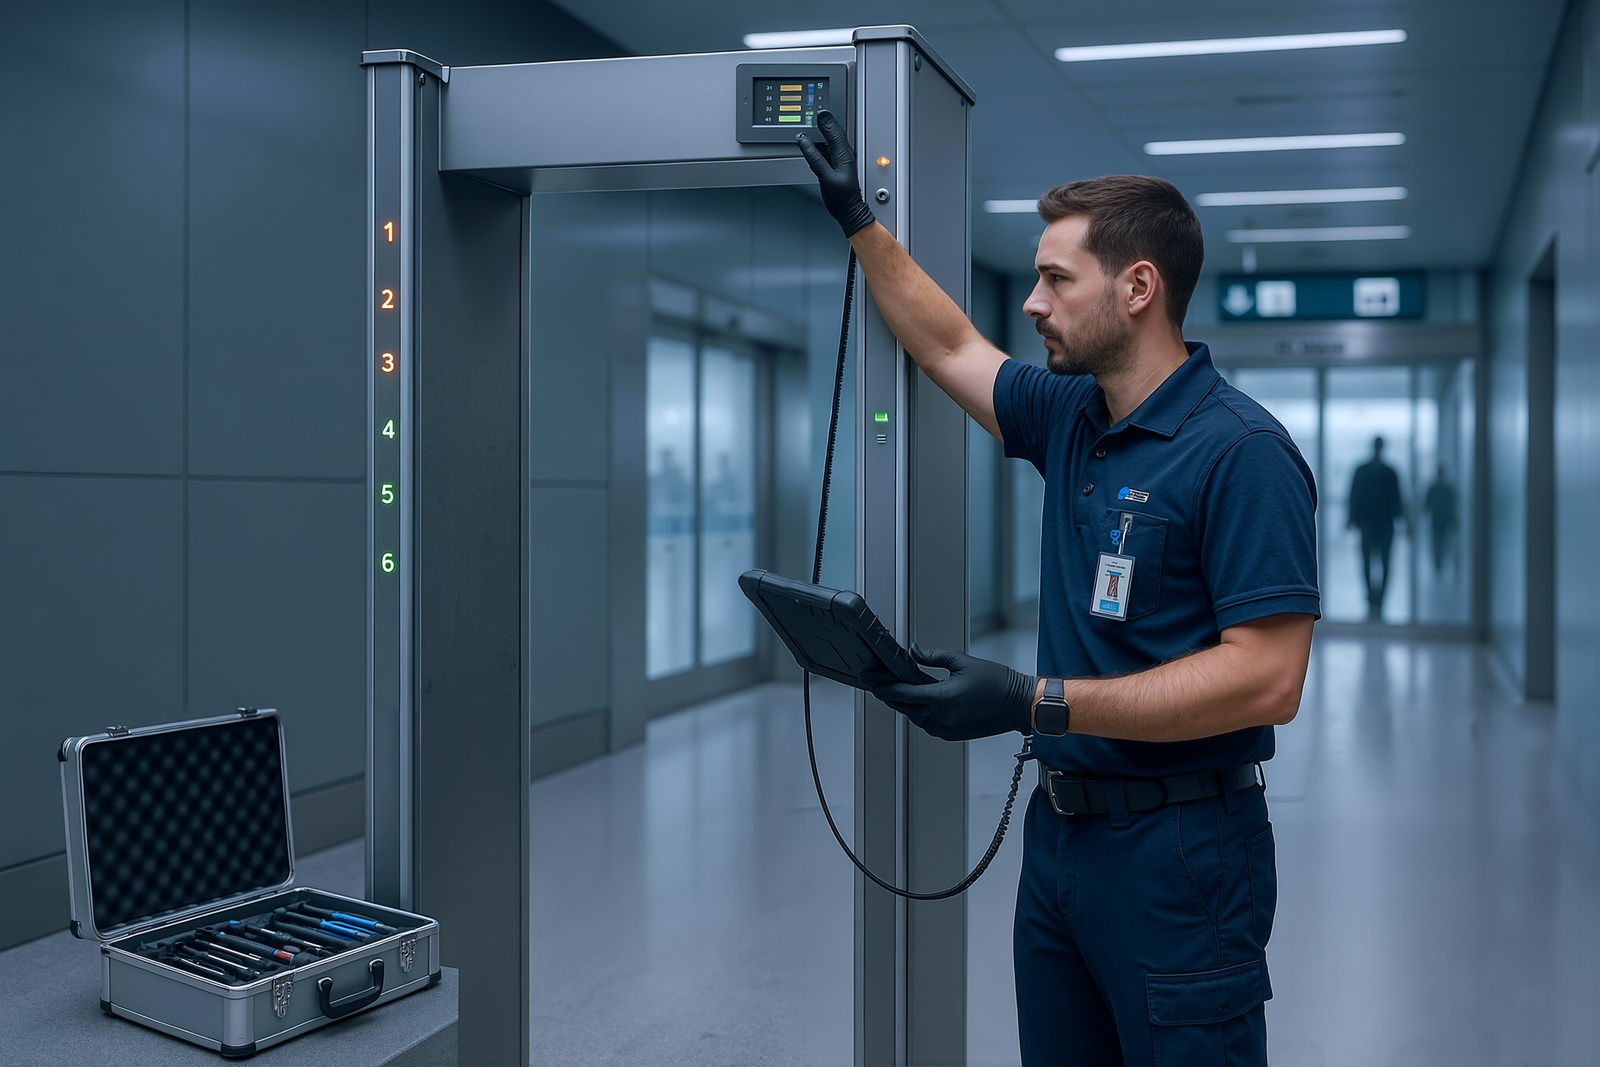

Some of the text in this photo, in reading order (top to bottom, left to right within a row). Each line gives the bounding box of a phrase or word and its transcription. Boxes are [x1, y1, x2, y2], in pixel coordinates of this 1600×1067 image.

[383, 221, 394, 242] 1
[381, 288, 395, 309] 2
[381, 352, 395, 373] 3
[381, 419, 396, 440] 4
[381, 484, 394, 504] 5
[381, 552, 395, 573] 6
